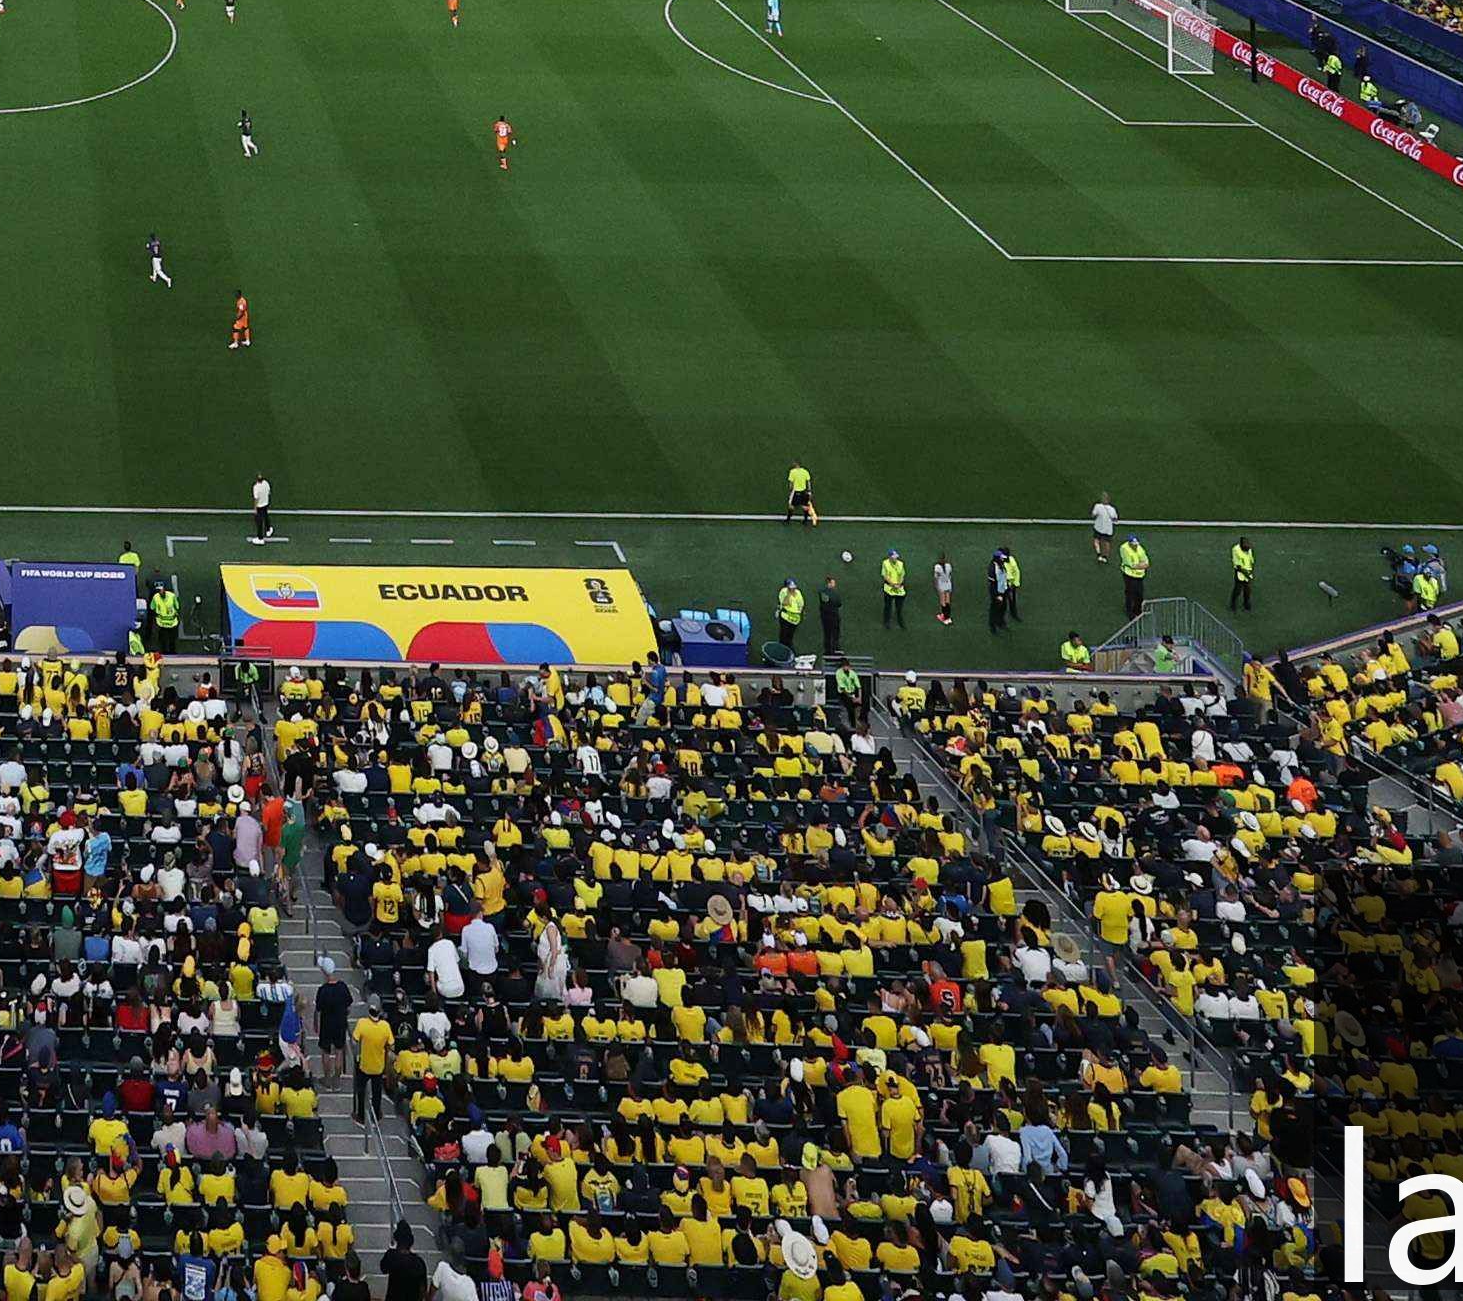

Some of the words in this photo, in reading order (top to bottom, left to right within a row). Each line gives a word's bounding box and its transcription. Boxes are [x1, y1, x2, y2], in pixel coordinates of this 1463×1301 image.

[21, 569, 41, 578] FIFA
[42, 569, 74, 578] WORLD
[75, 570, 93, 579] CUP
[378, 583, 528, 602] ECUADOR
